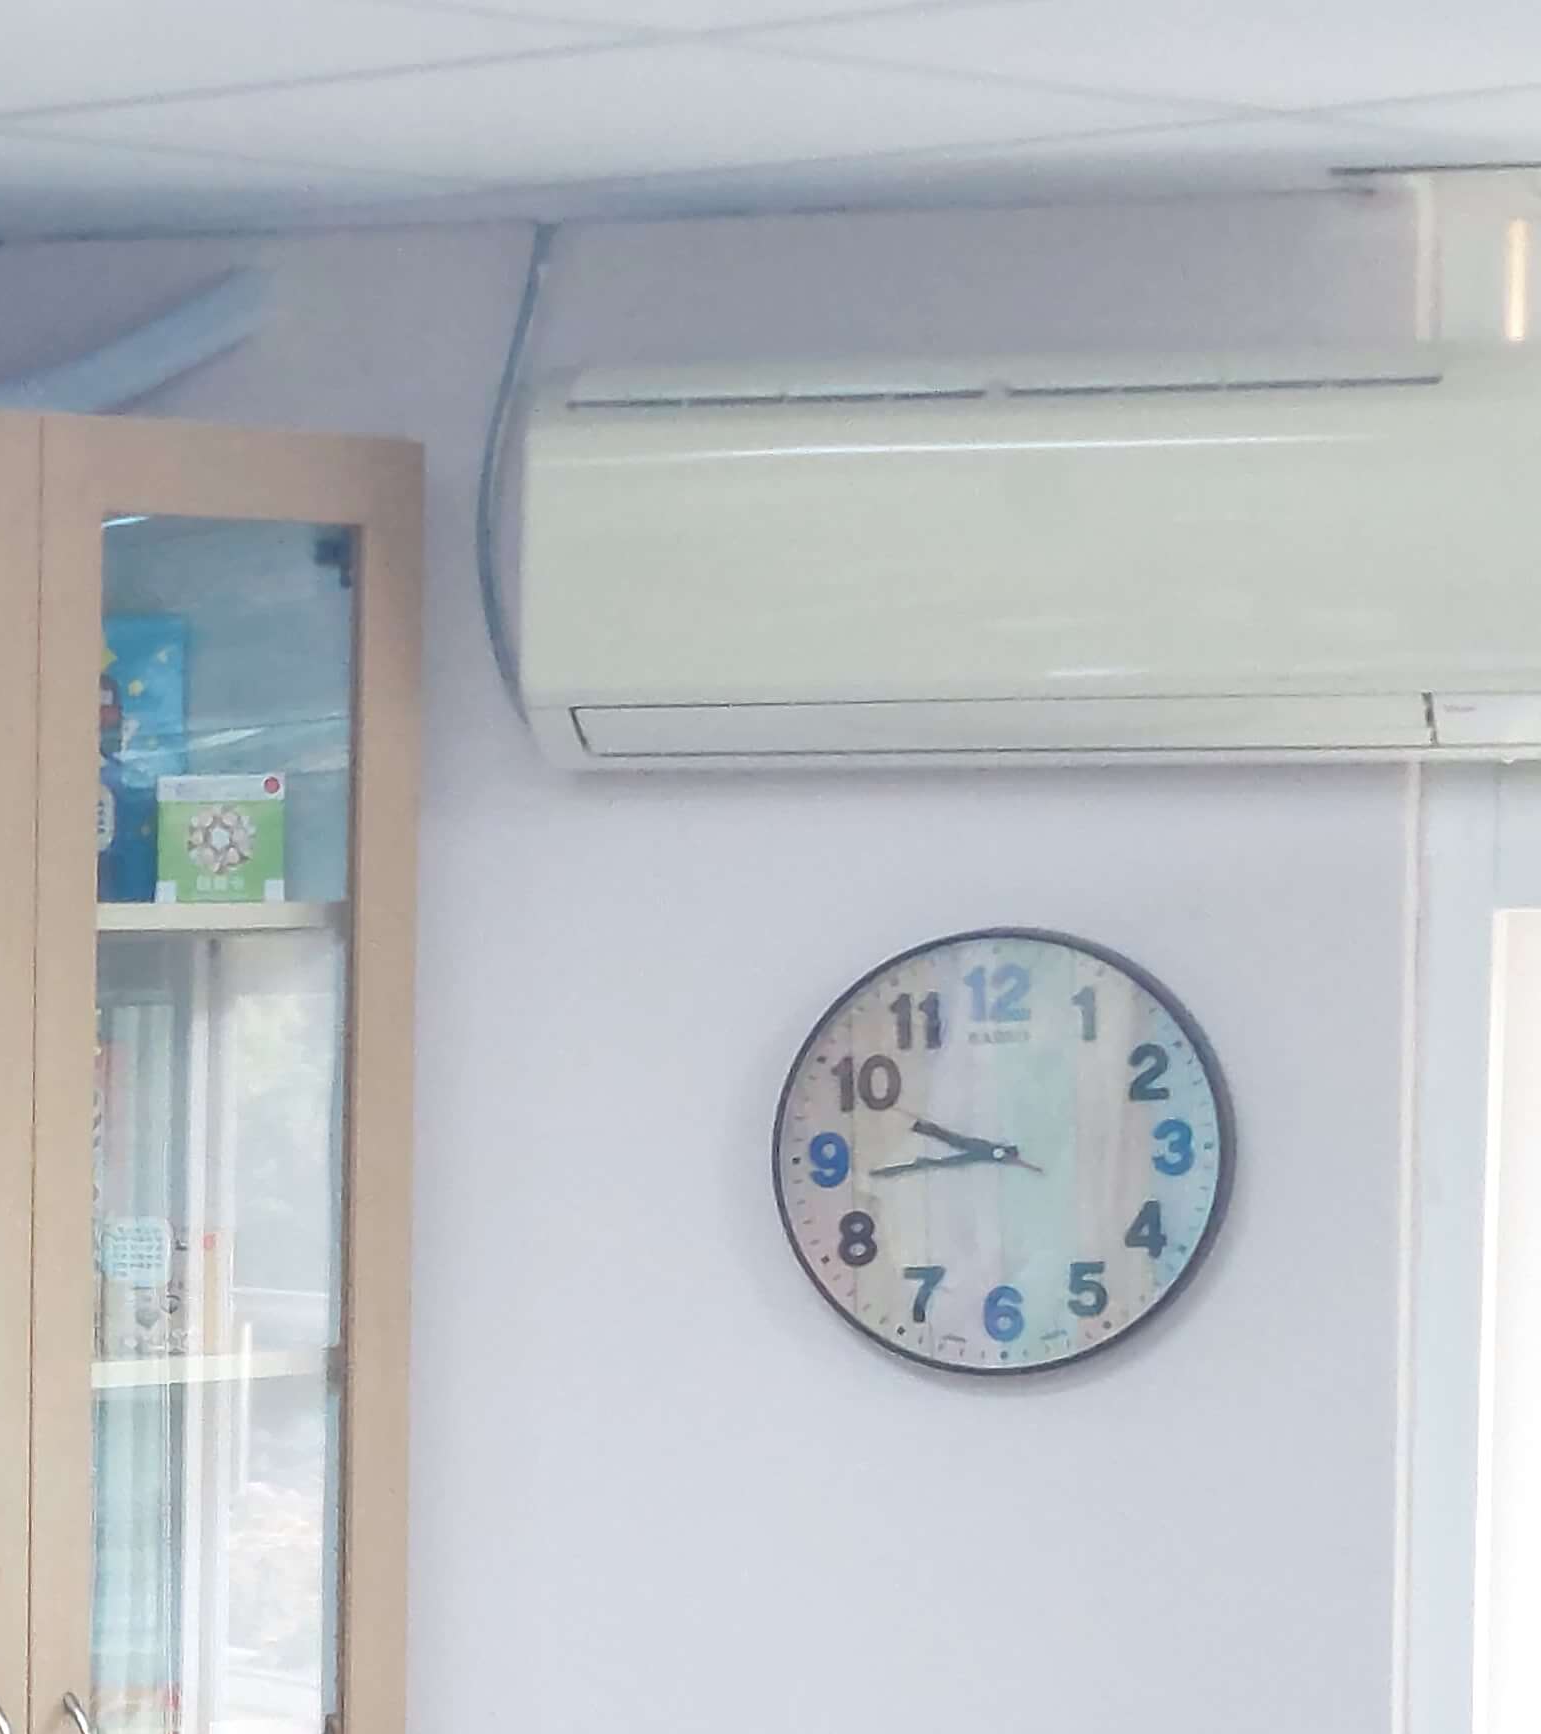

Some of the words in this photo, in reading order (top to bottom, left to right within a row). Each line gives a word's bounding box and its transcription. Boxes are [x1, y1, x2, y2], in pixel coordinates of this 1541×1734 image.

[964, 963, 1030, 1022] 12
[1072, 986, 1097, 1041] 1
[890, 992, 942, 1050] 11
[832, 1055, 901, 1112] 10
[1128, 1044, 1170, 1101] 2
[809, 1132, 849, 1188] 9
[1152, 1119, 1192, 1176] 3
[838, 1211, 877, 1267] 8
[1125, 1200, 1167, 1258] 4
[904, 1267, 945, 1323] 7
[983, 1286, 1024, 1342] 6
[1069, 1261, 1107, 1317] 5
